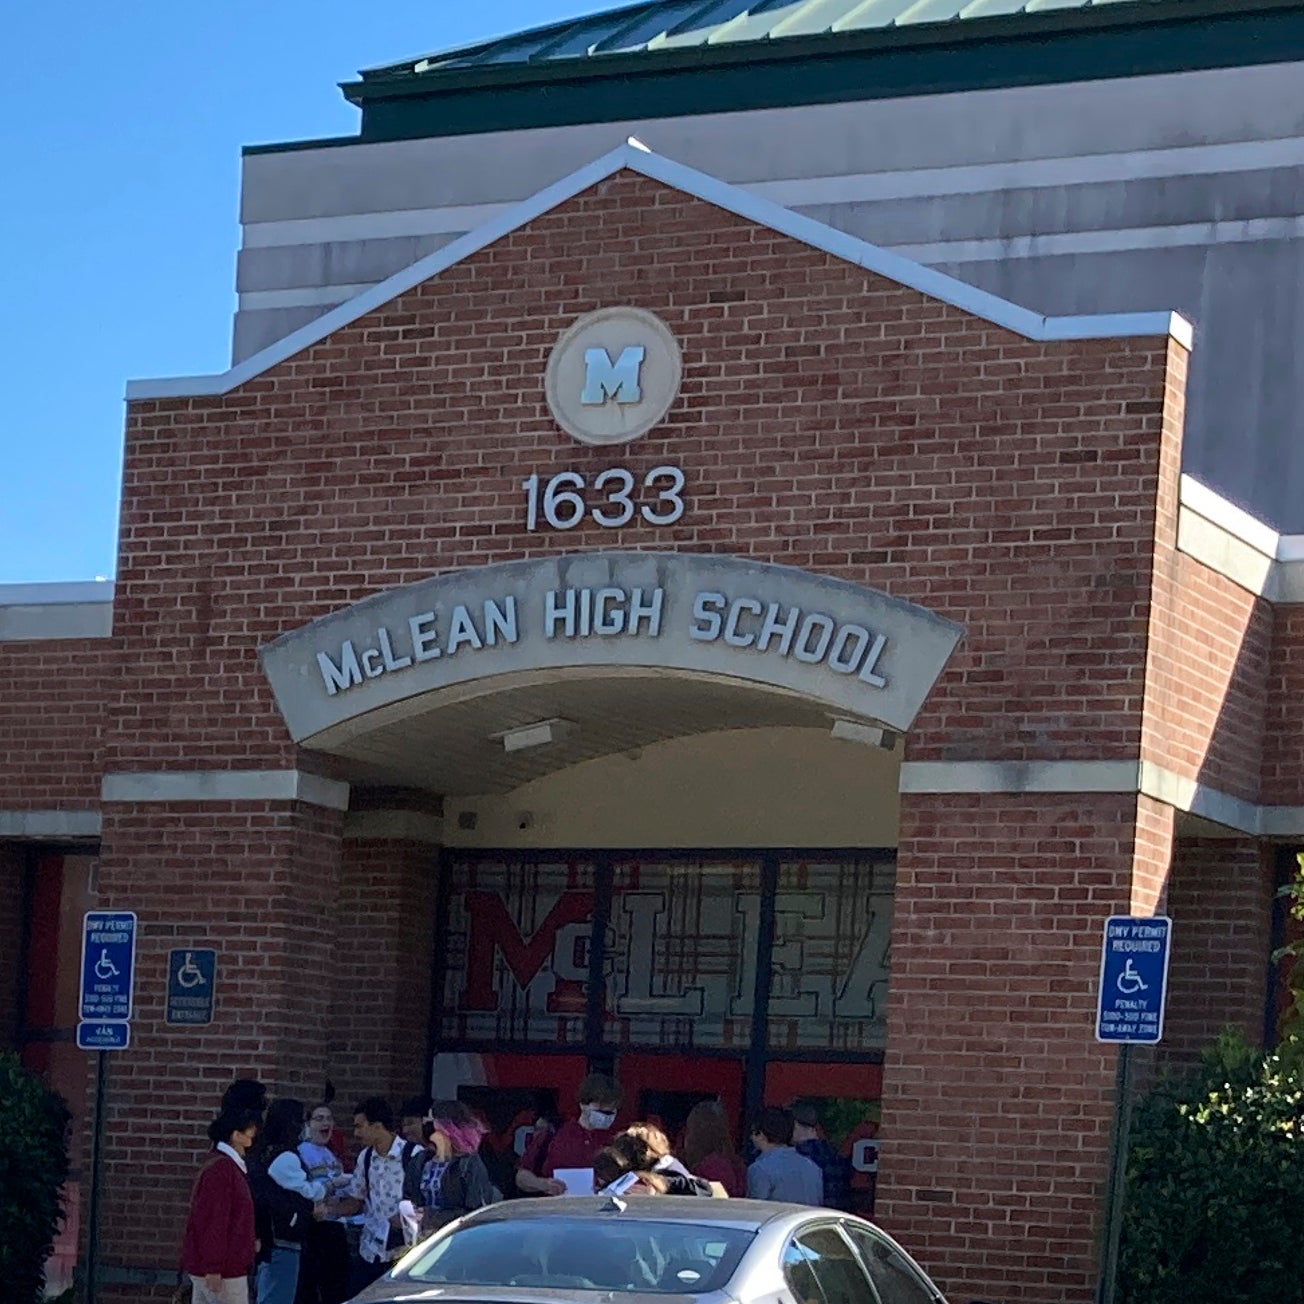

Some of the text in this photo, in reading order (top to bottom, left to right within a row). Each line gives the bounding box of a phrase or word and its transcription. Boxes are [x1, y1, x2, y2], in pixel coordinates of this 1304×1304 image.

[581, 346, 645, 405] M
[521, 466, 686, 531] 1633
[316, 587, 889, 696] McLEAN HIGH SCHOOL
[1132, 925, 1166, 938] PERMIT
